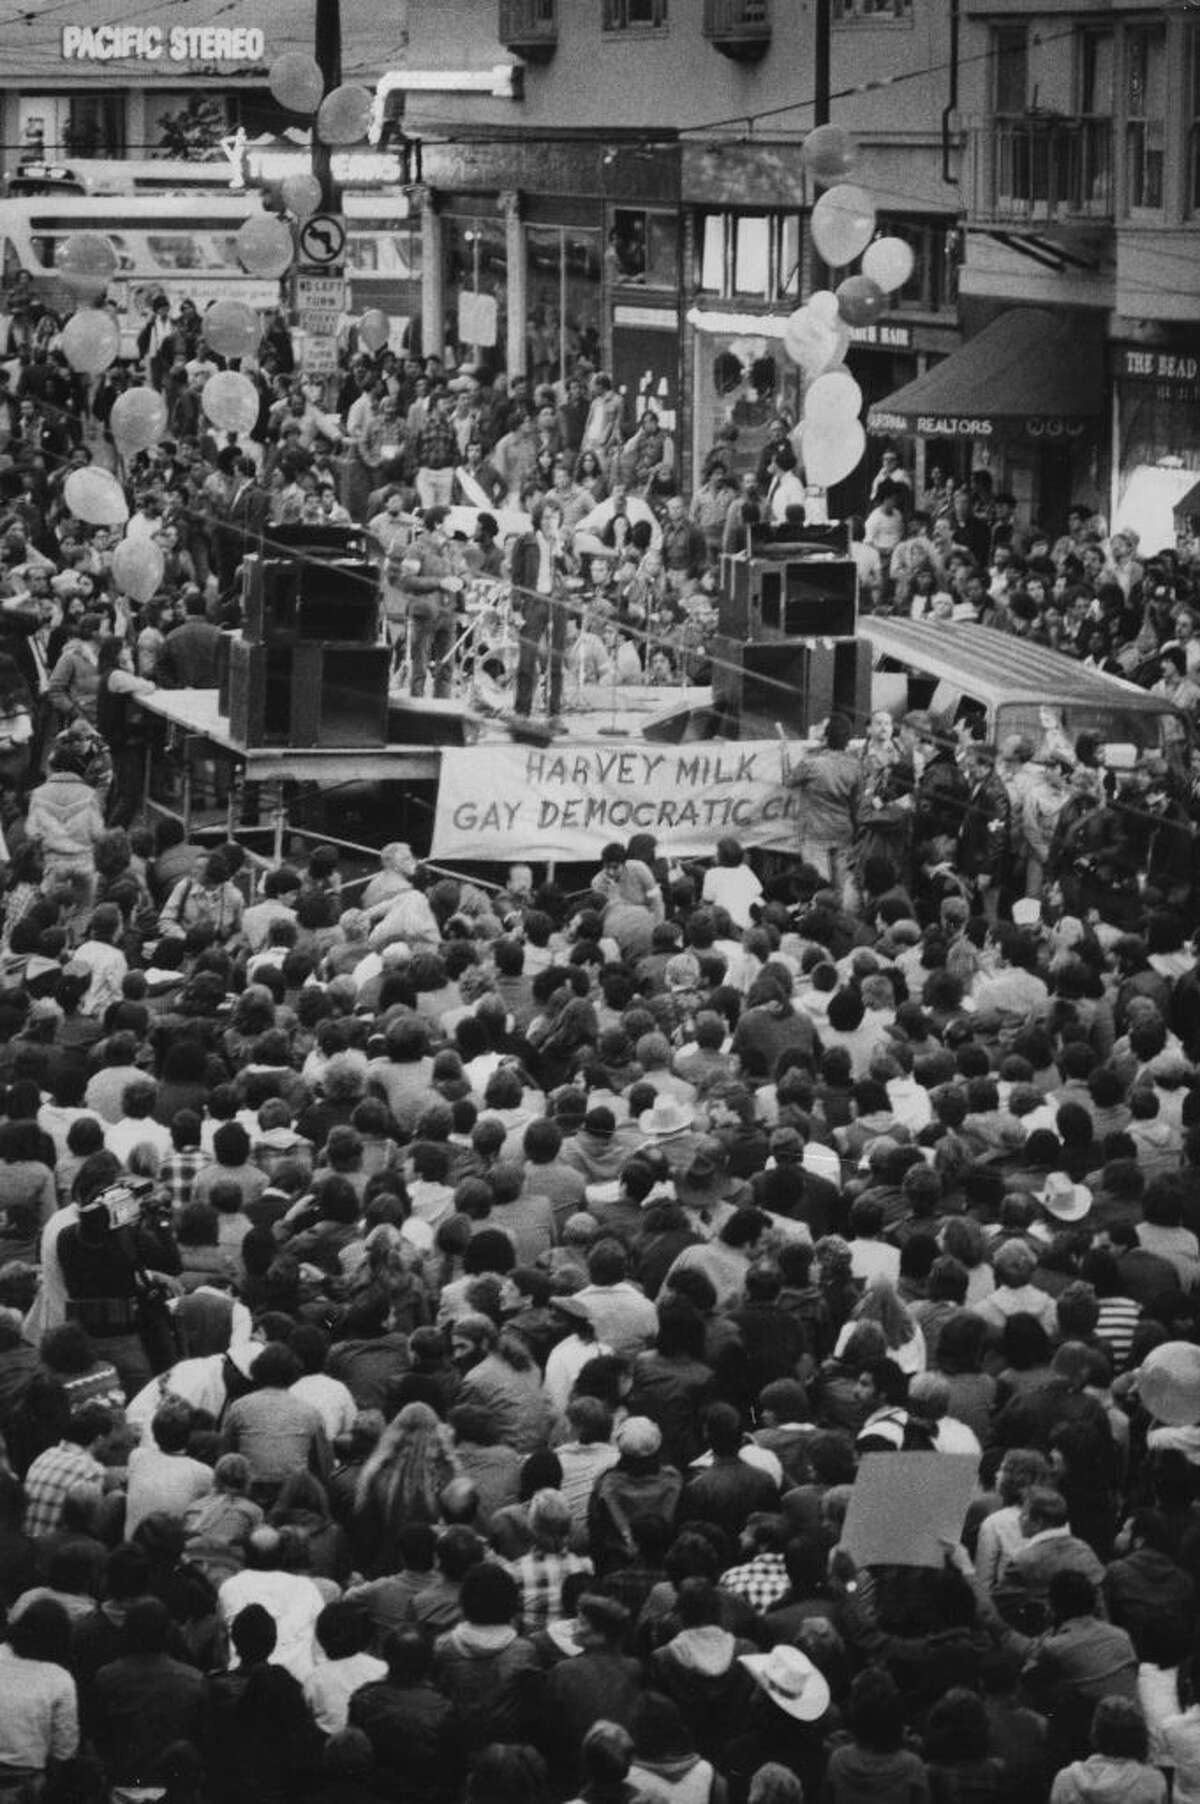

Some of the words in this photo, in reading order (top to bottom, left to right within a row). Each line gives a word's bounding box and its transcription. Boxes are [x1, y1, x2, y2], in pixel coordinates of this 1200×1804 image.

[63, 26, 162, 59] PACIFIC
[169, 26, 264, 60] STEREO
[314, 282, 342, 292] LEFT
[1126, 351, 1154, 374] THE
[1158, 354, 1198, 380] BEAD
[917, 417, 993, 435] REALTORS
[525, 751, 666, 786] HARVEY
[675, 752, 757, 787] MILK
[453, 801, 521, 832] GAY
[537, 797, 754, 829] DEMOCRATIC
